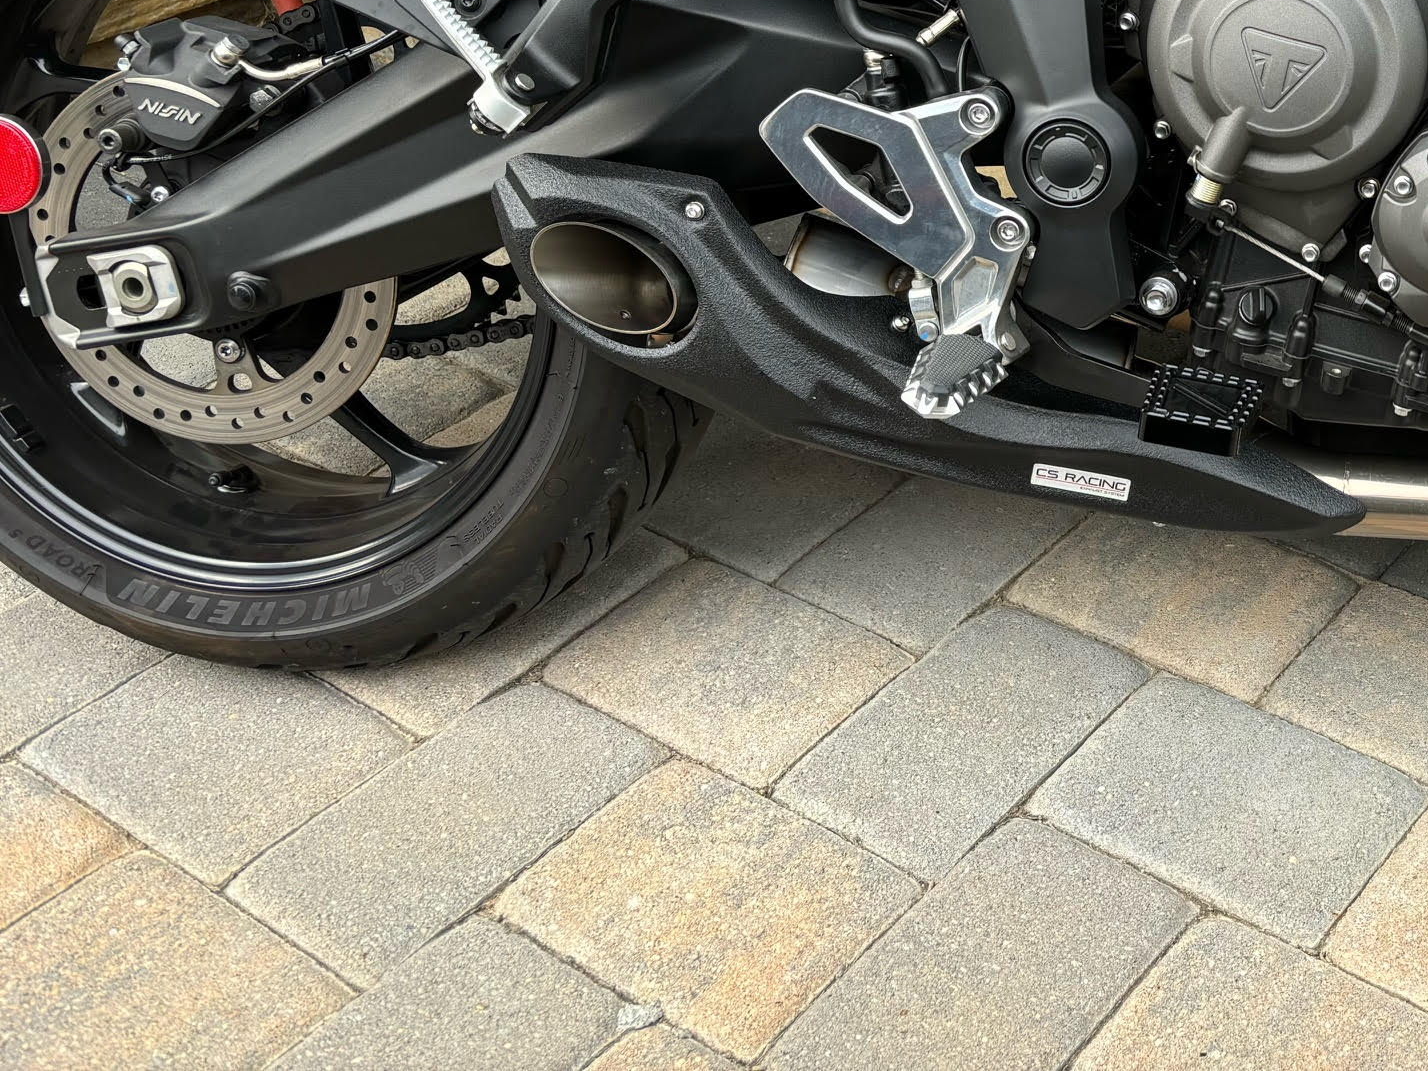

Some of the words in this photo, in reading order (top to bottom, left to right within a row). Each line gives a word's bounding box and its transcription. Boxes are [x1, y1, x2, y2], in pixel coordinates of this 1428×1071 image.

[1036, 468, 1059, 479] CS
[1064, 472, 1127, 492] RACING
[25, 535, 92, 578] ROAD
[117, 578, 371, 626] MICHELIN
